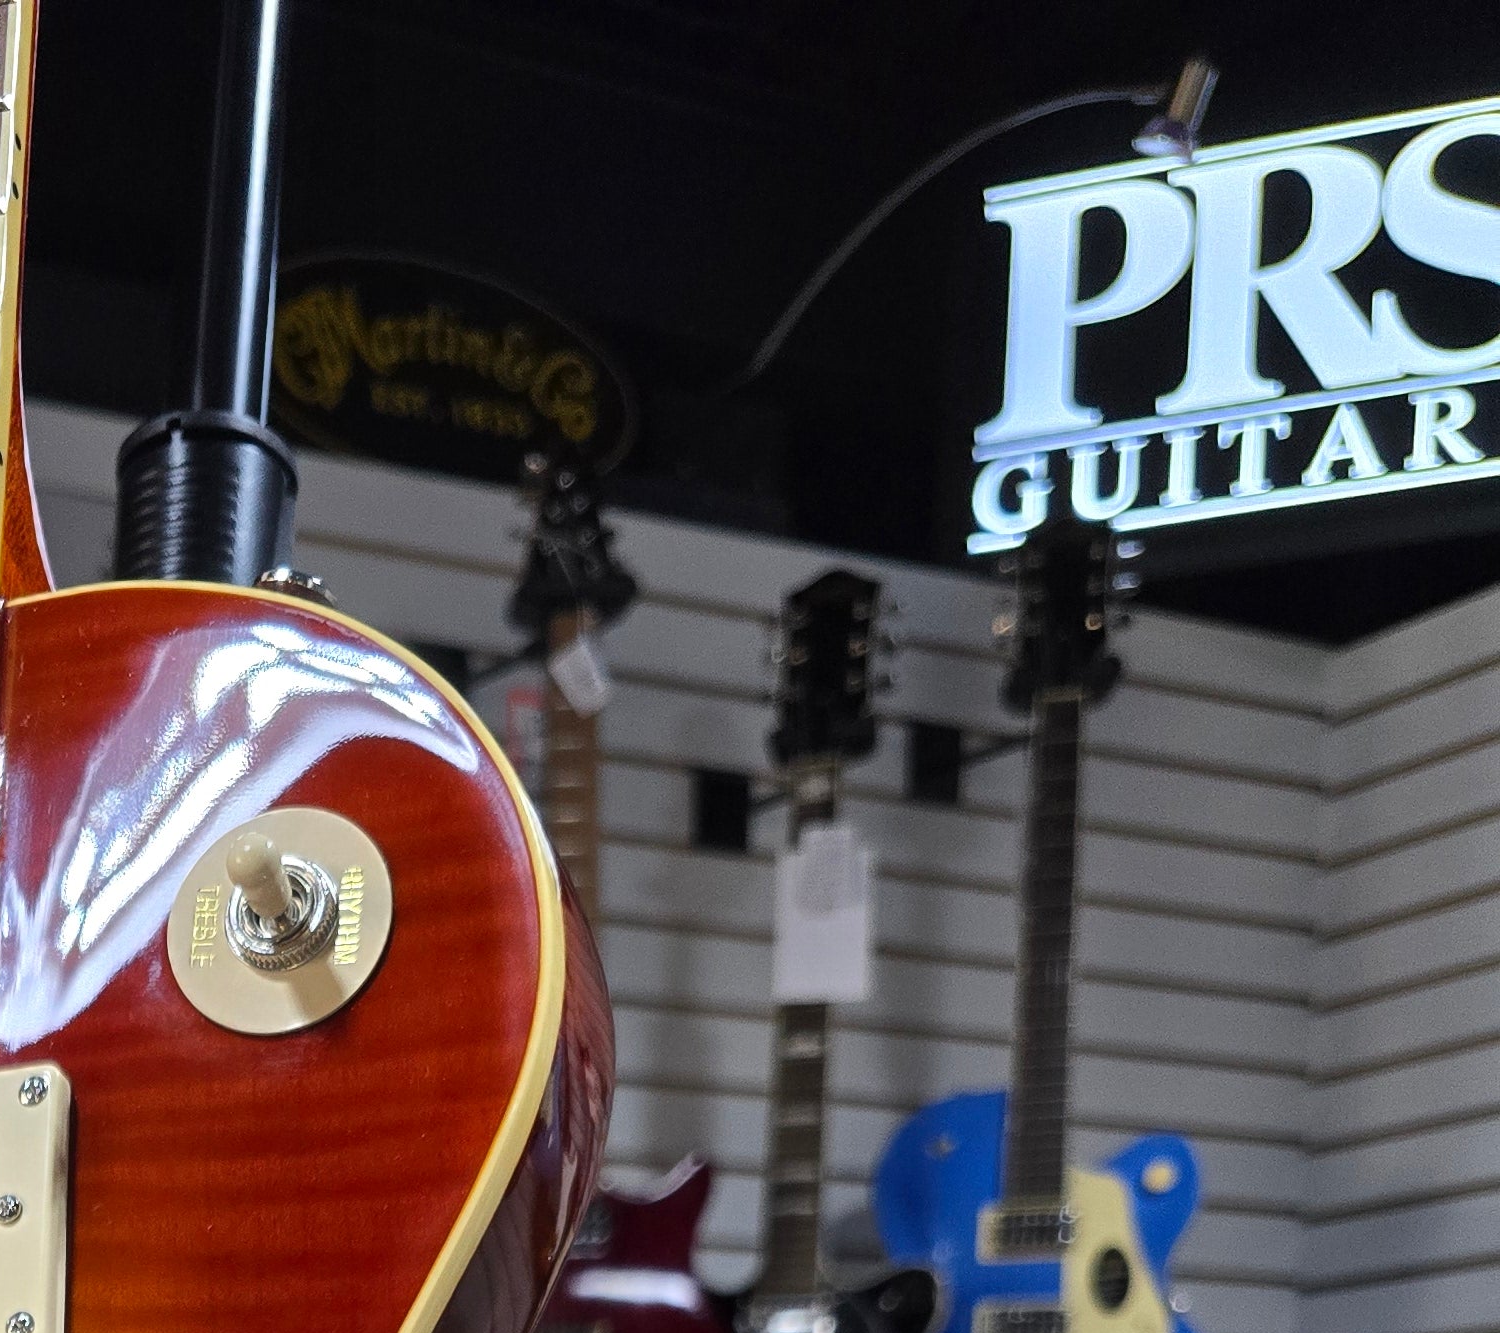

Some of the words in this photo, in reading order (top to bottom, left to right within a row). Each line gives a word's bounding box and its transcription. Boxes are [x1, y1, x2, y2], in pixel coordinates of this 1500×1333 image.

[974, 111, 1500, 446] PRS
[189, 884, 222, 969] TREBLE
[333, 866, 365, 966] RHYTHM
